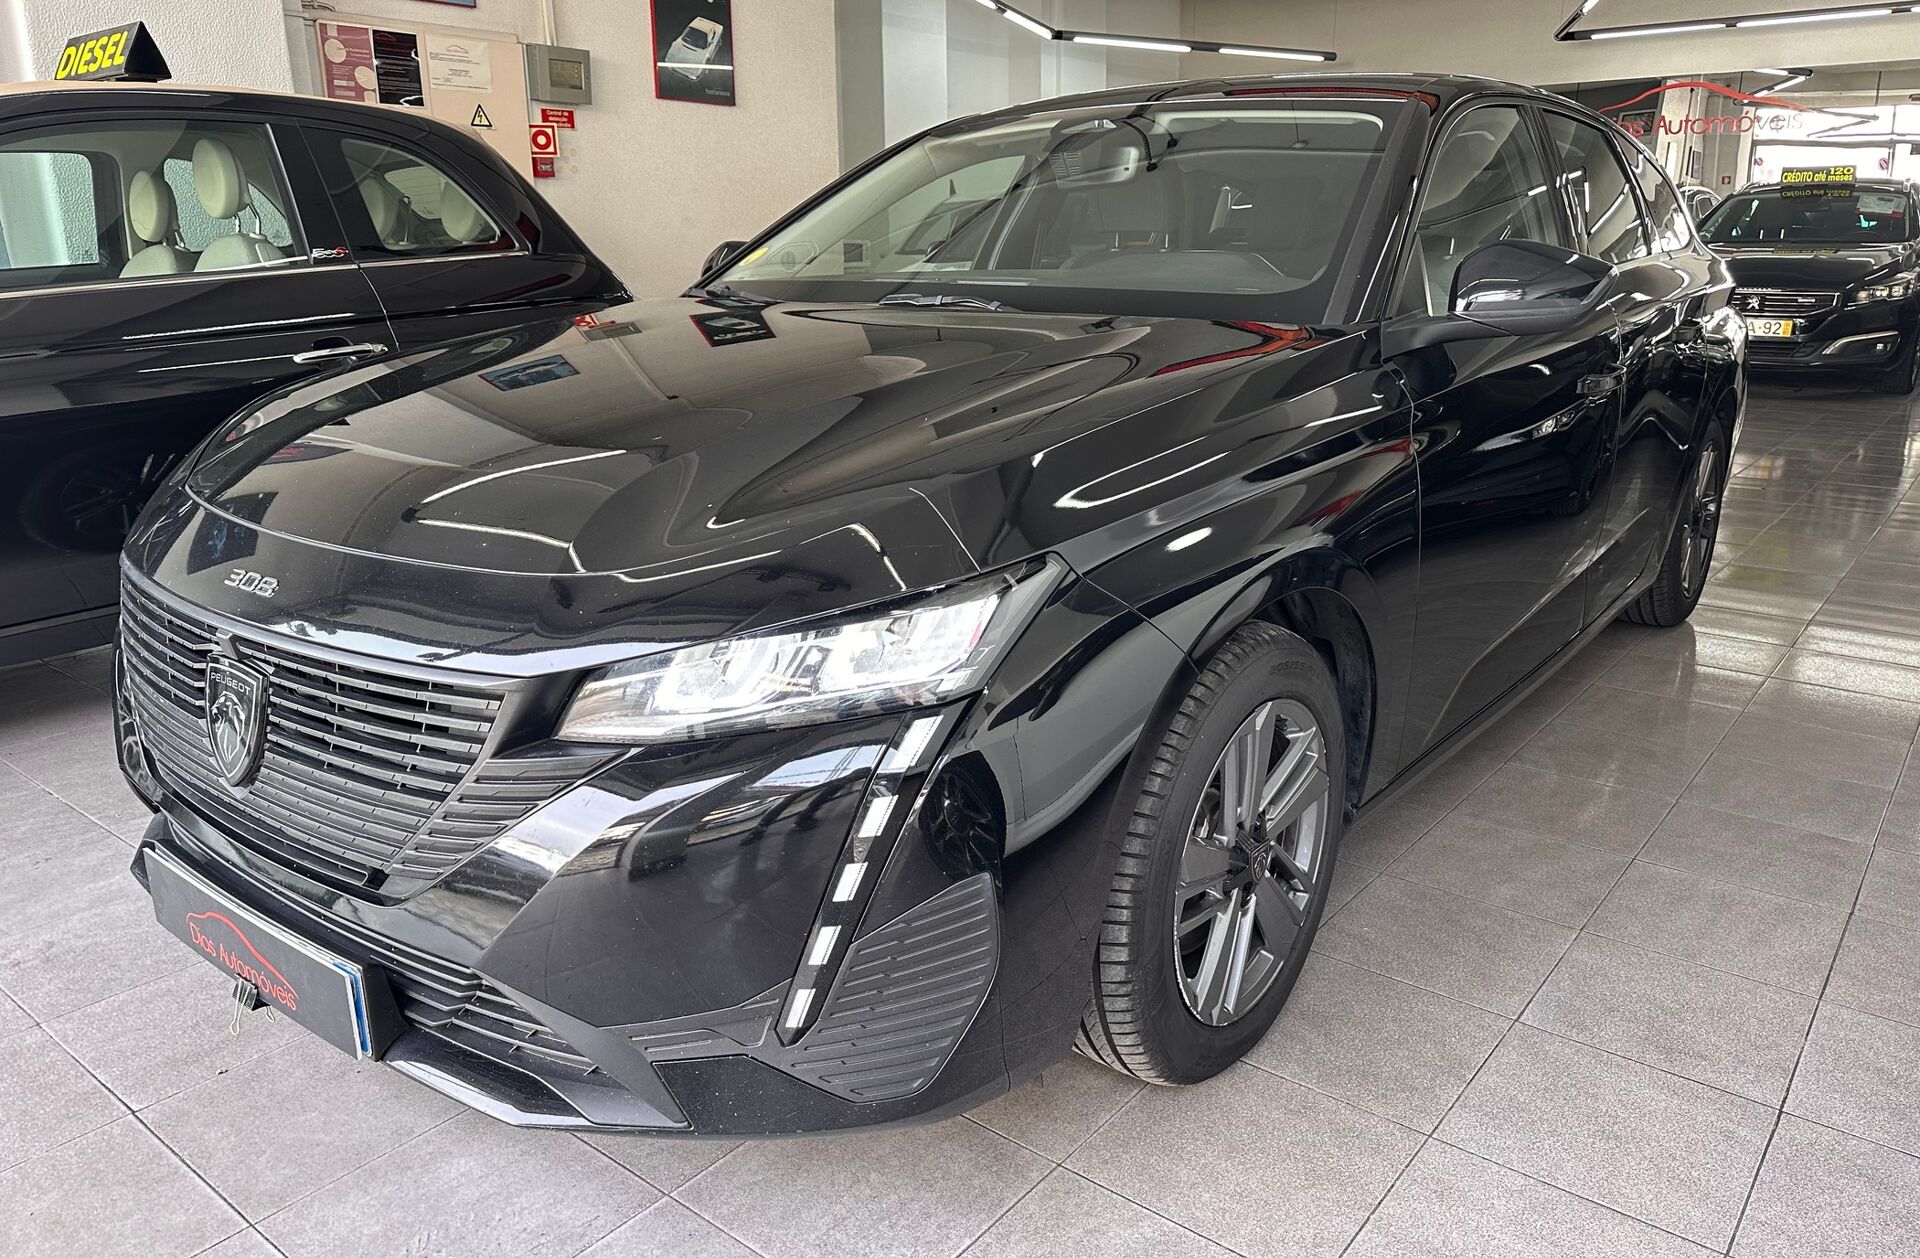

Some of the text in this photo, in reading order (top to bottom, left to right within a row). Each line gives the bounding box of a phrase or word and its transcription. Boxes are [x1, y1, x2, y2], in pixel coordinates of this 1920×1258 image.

[56, 31, 128, 80] DIESEL
[1655, 110, 1804, 136] Automóveis
[1782, 169, 1827, 183] CRÉDITO até
[1827, 174, 1853, 182] meses
[1828, 167, 1854, 175] 120
[224, 568, 279, 598] 308
[210, 671, 251, 696] PEUGEOT
[189, 921, 298, 1011] Dias Automóveis
